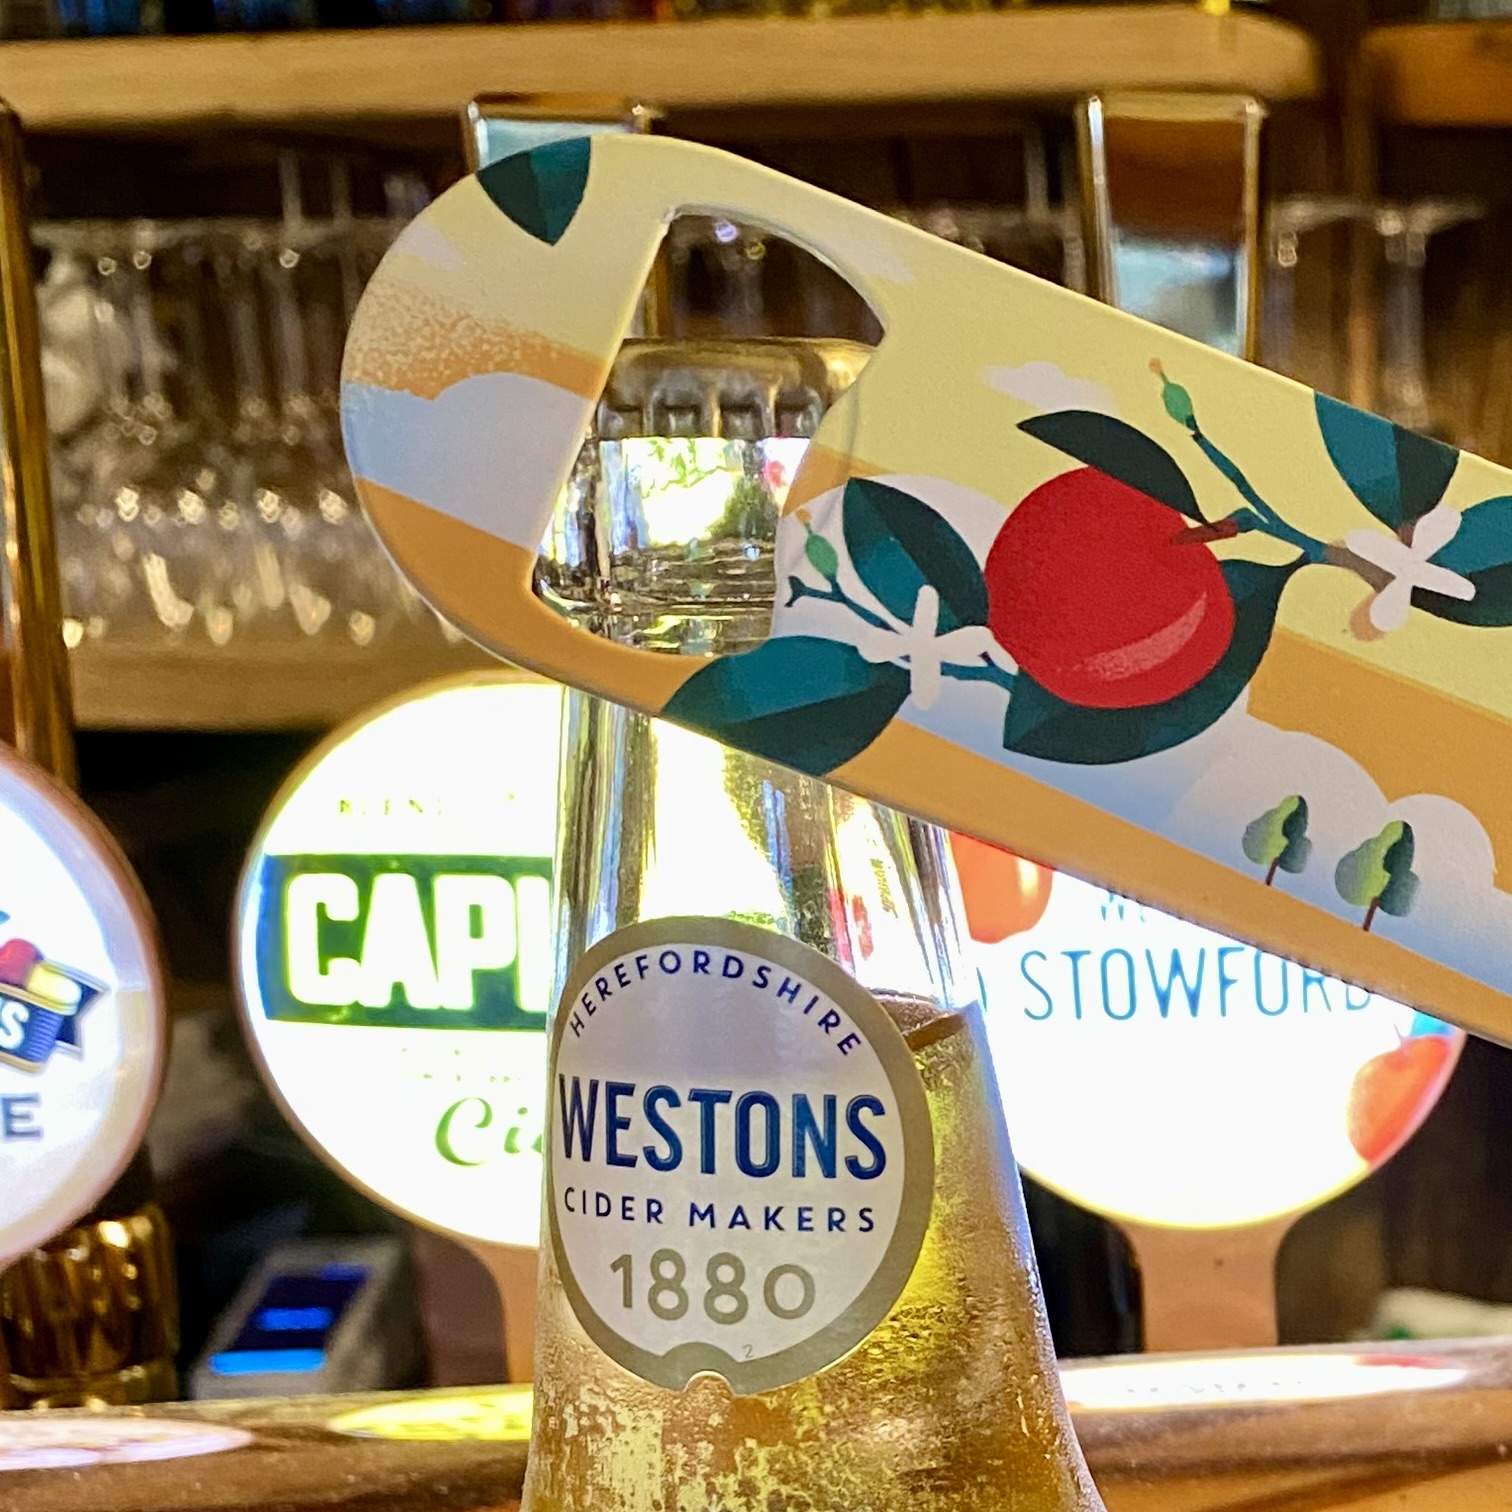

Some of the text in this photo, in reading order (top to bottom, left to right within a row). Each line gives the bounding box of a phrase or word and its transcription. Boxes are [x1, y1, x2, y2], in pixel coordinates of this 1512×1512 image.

[570, 950, 862, 1056] HEREFORDSHIRE
[434, 1097, 543, 1167] Ci
[559, 1073, 887, 1180] WESTONS
[564, 1187, 875, 1233] CIDER MAKERS
[610, 1248, 816, 1326] 1880
